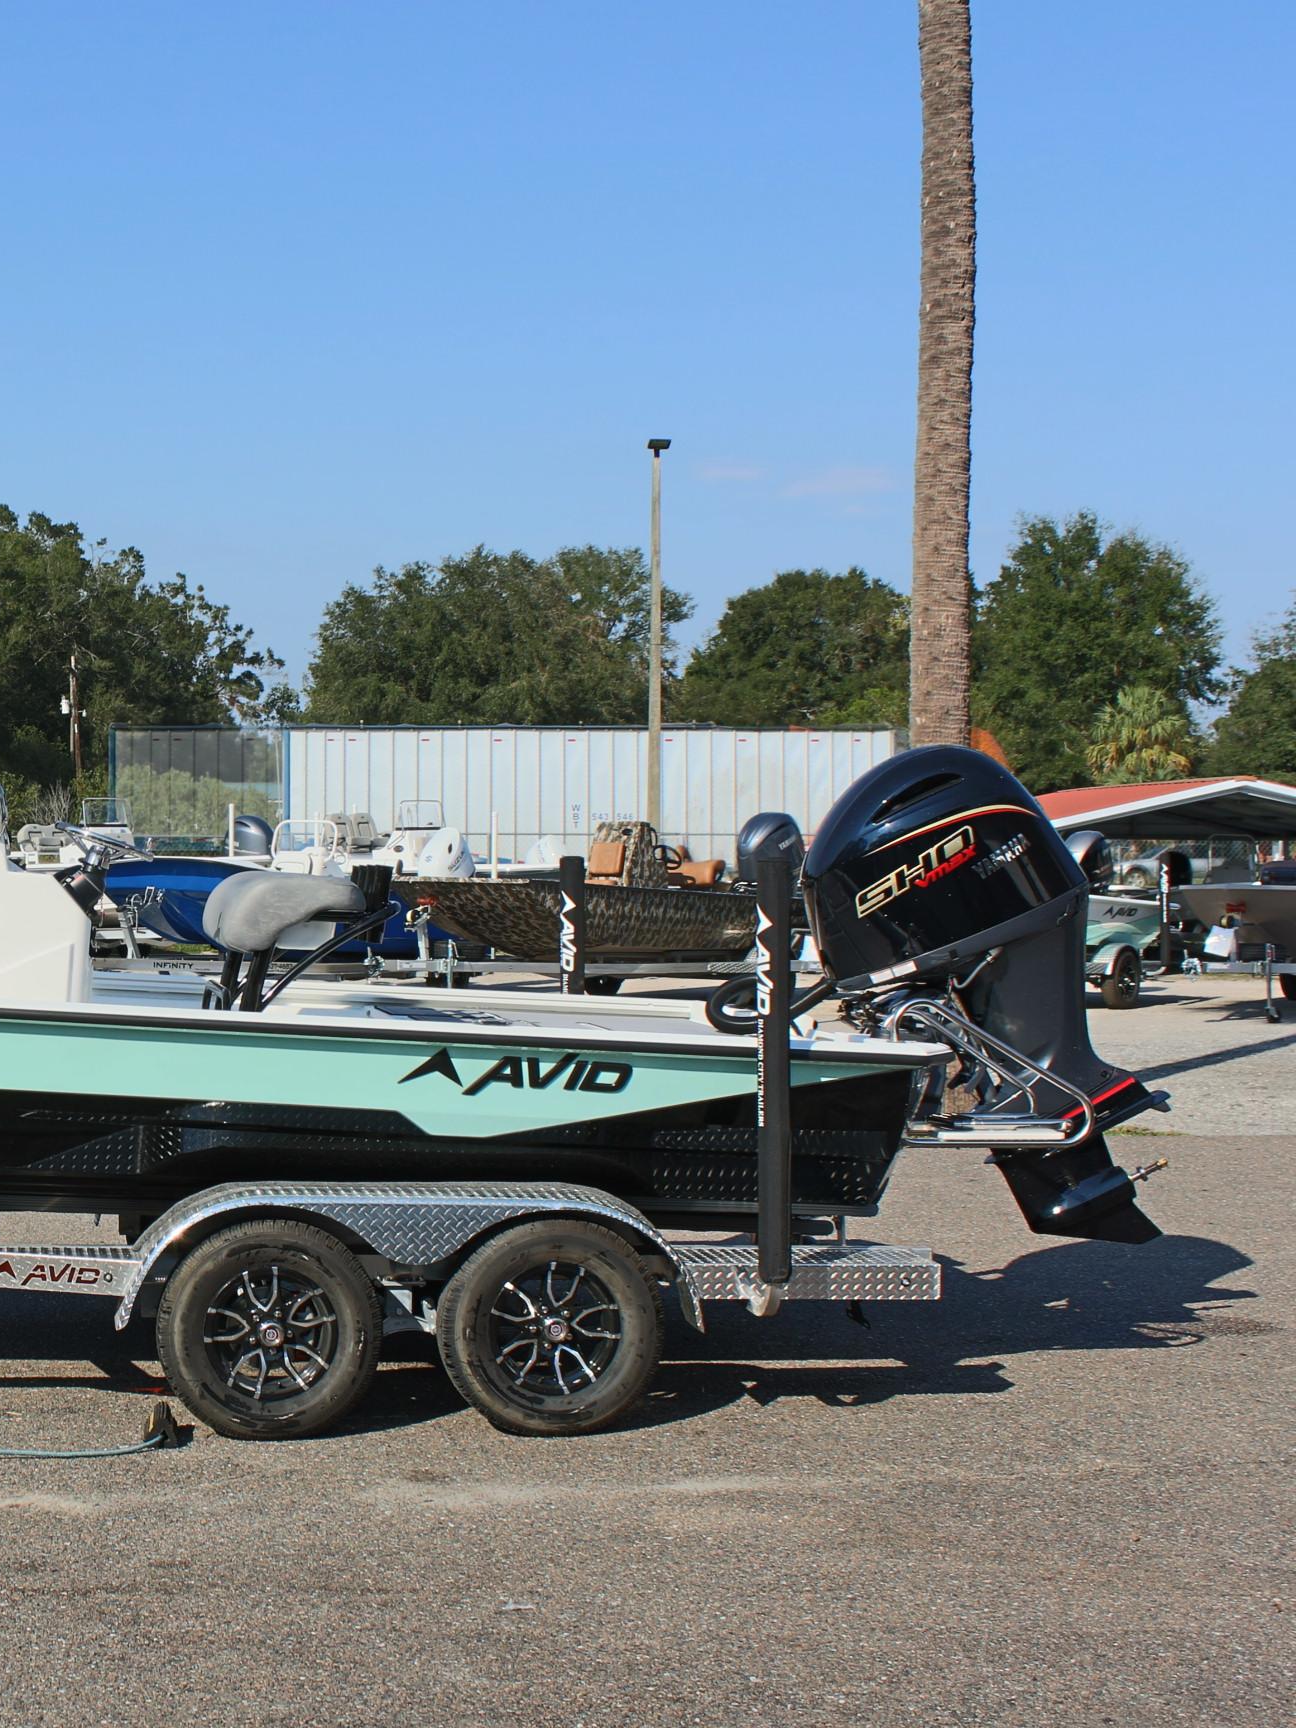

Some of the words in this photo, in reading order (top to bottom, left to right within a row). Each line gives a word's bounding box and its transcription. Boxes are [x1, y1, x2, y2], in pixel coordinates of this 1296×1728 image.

[855, 825, 975, 919] SHO
[971, 832, 1032, 880] YAMAHA
[153, 961, 193, 969] INFINITY
[560, 912, 577, 972] AVID
[755, 935, 774, 1016] AVID
[461, 1053, 634, 1096] AVID
[21, 1252, 101, 1286] AVID
